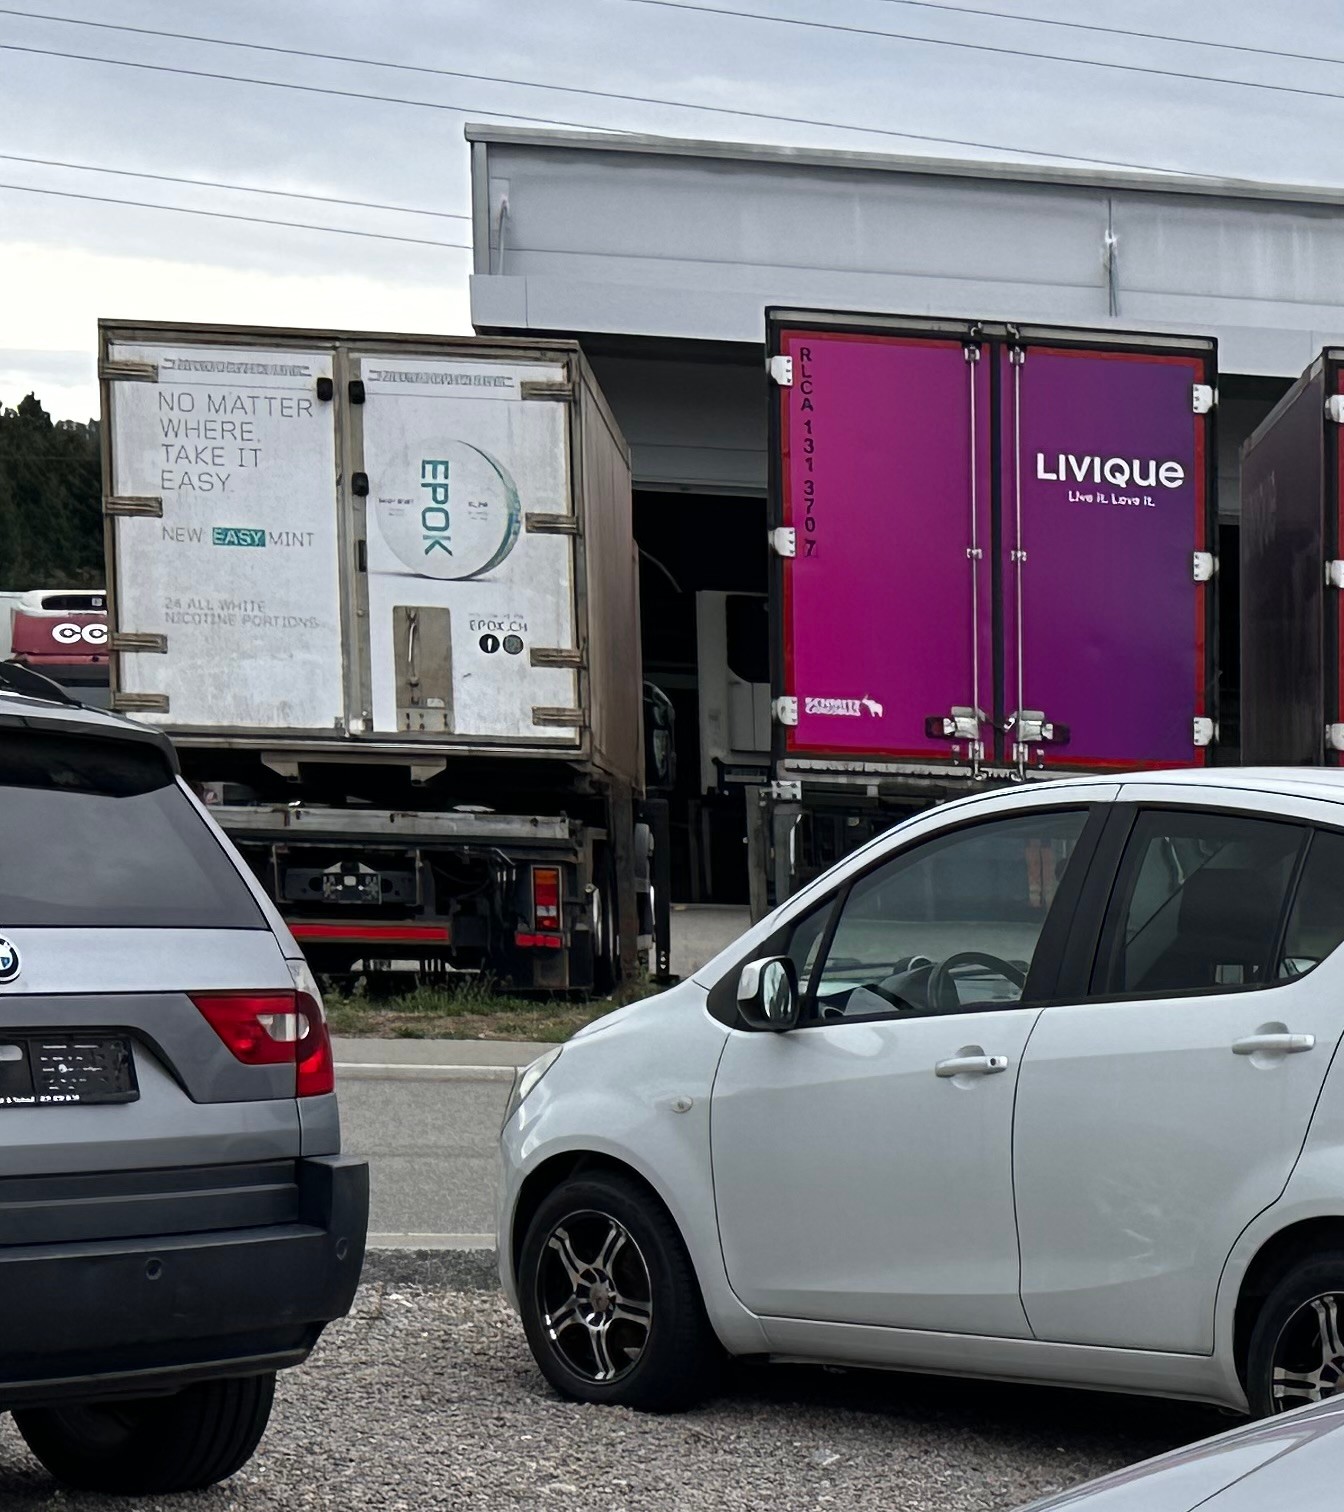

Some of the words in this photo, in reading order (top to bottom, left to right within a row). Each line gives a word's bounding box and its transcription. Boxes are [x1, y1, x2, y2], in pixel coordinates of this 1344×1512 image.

[800, 346, 814, 412] RLCA
[158, 391, 195, 413] NO
[207, 393, 313, 418] MATTER
[161, 443, 225, 467] TAKE
[237, 447, 262, 468] IT
[803, 419, 815, 472] 131
[421, 459, 453, 557] EPOK
[803, 479, 816, 533] 370
[162, 526, 202, 543] NEW
[213, 528, 263, 546] EASY
[269, 531, 315, 547] MINT
[804, 539, 816, 557] 7
[187, 599, 214, 611] ALL
[220, 600, 266, 613] WHITE
[165, 612, 236, 627] NICOTINE
